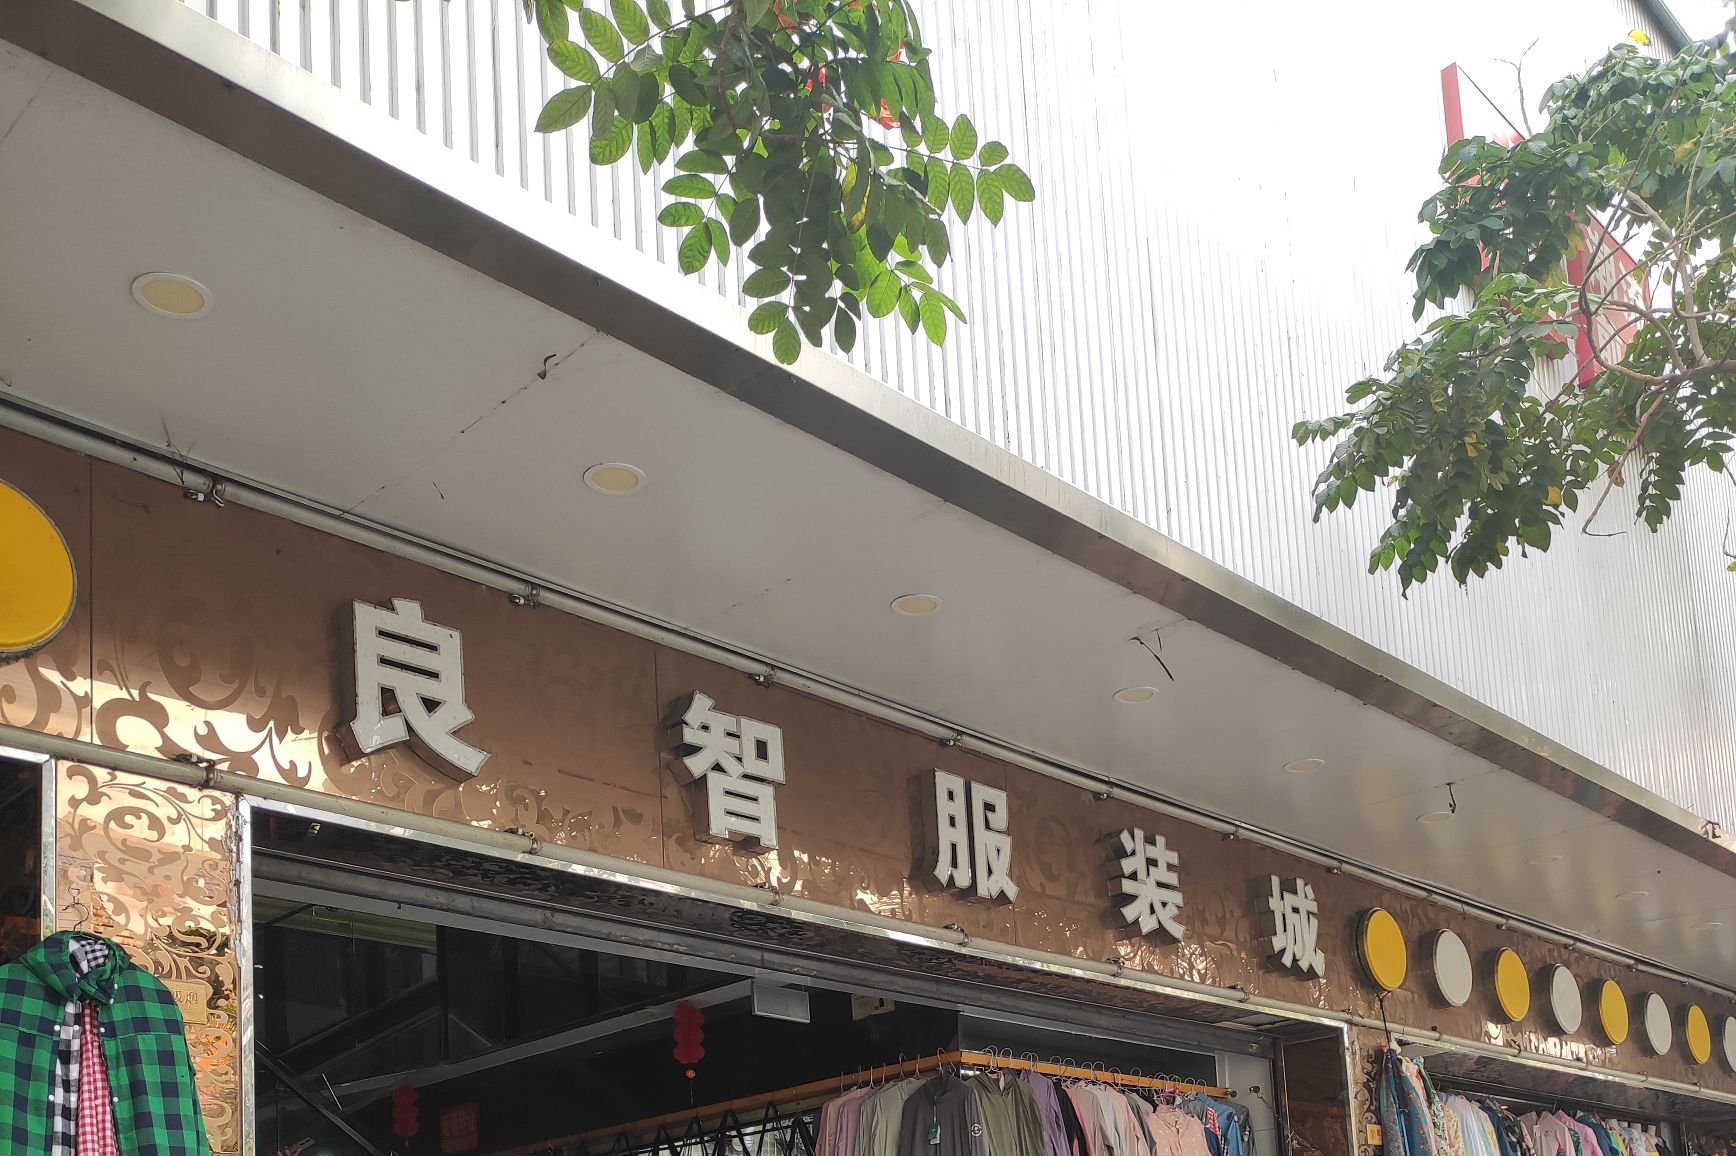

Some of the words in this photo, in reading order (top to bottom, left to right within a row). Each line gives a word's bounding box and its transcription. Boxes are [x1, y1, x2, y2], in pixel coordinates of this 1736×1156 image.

[350, 597, 1326, 978] 良智服装城
